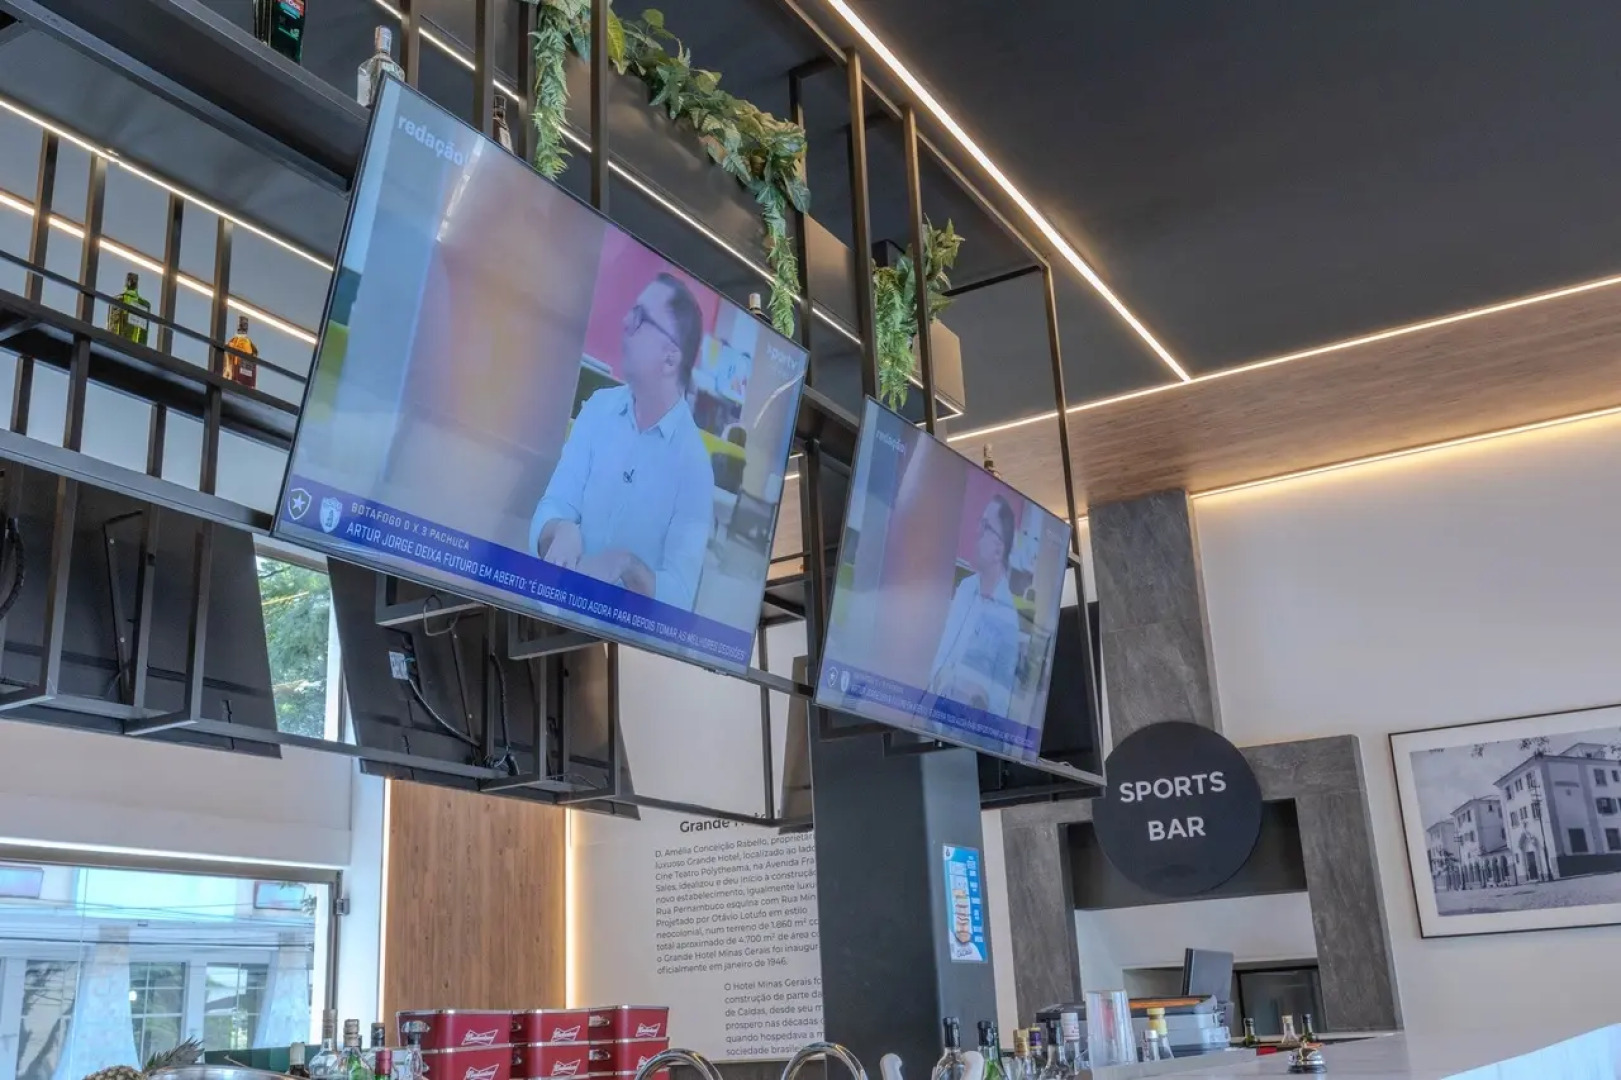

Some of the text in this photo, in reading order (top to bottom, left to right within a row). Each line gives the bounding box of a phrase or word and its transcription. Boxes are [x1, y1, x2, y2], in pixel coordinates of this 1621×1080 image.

[398, 116, 464, 166] redação
[352, 502, 401, 528] BOTAFOGO
[412, 523, 421, 533] X
[430, 529, 470, 551] PACHUCA
[346, 521, 381, 544] ARTUR
[381, 533, 413, 554] JORGE
[414, 542, 442, 563] DEIXA
[444, 552, 479, 574] FUTURO
[479, 563, 492, 577] EM
[493, 567, 528, 591] ABERTO:
[537, 582, 567, 604] DIGERIR
[568, 593, 588, 610] TUDO
[587, 598, 612, 618] AGORA
[613, 607, 632, 625] PARA
[632, 613, 655, 632] DEPOIS
[655, 619, 679, 641] TOMAR
[678, 630, 687, 643] AS
[1119, 771, 1227, 803] SPORTS
[680, 818, 730, 833] Grande
[1147, 816, 1206, 841] BAR
[655, 850, 662, 858] D.
[665, 847, 692, 857] Amélia
[693, 841, 736, 853] Conceição
[736, 837, 769, 849] Rabello,
[655, 860, 686, 870] luxuoso
[687, 855, 716, 866] Grande
[718, 852, 742, 863] Hotel,
[743, 847, 784, 859] localizado
[786, 846, 797, 854] ao
[655, 872, 673, 881] Cine
[675, 870, 700, 878] Teatro
[753, 863, 764, 871] na
[765, 858, 800, 869] Avenida
[679, 880, 715, 890] idealizou
[723, 877, 739, 885] deu
[740, 874, 763, 884] início
[656, 896, 675, 904] novo
[676, 889, 746, 902] estabelecimento,
[747, 884, 795, 896] igualmente
[656, 907, 671, 915] Rua
[673, 903, 725, 914] Pernambuco
[726, 899, 759, 909] esquina
[760, 897, 780, 906] com
[781, 895, 798, 904] Rua
[656, 915, 694, 928] Projetado
[696, 916, 710, 925] por
[711, 912, 739, 923] Otávio
[768, 908, 782, 917] em
[784, 906, 808, 916] estilo
[656, 927, 704, 939] neocolonial,
[705, 926, 725, 934] num
[726, 922, 757, 933] terreno
[758, 922, 769, 930] de
[656, 941, 675, 951] total
[676, 938, 725, 949] aproximado
[725, 936, 737, 945] de
[777, 931, 789, 940] de
[790, 931, 809, 939] área
[664, 952, 693, 962] Grande
[694, 950, 717, 959] Hotel
[718, 948, 743, 957] Minas
[744, 946, 771, 956] Gerais
[772, 945, 784, 953] foi
[657, 964, 708, 975] oficialmente
[709, 963, 723, 971] em
[723, 960, 753, 971] janeiro
[754, 958, 766, 967] de
[724, 982, 732, 991] O
[733, 981, 755, 990] Hotel
[757, 979, 782, 989] Minas
[784, 977, 812, 987] Gerais
[724, 993, 772, 1004] construção
[773, 992, 785, 1001] de
[786, 991, 810, 1002] parte
[725, 1009, 736, 1017] de
[769, 1004, 796, 1014] desde
[797, 1004, 813, 1013] seu
[764, 1019, 780, 1028] nas
[781, 1017, 818, 1027] décadas
[726, 1033, 758, 1043] quando
[760, 1031, 808, 1042] hospedava
[726, 1045, 769, 1056] sociedade
